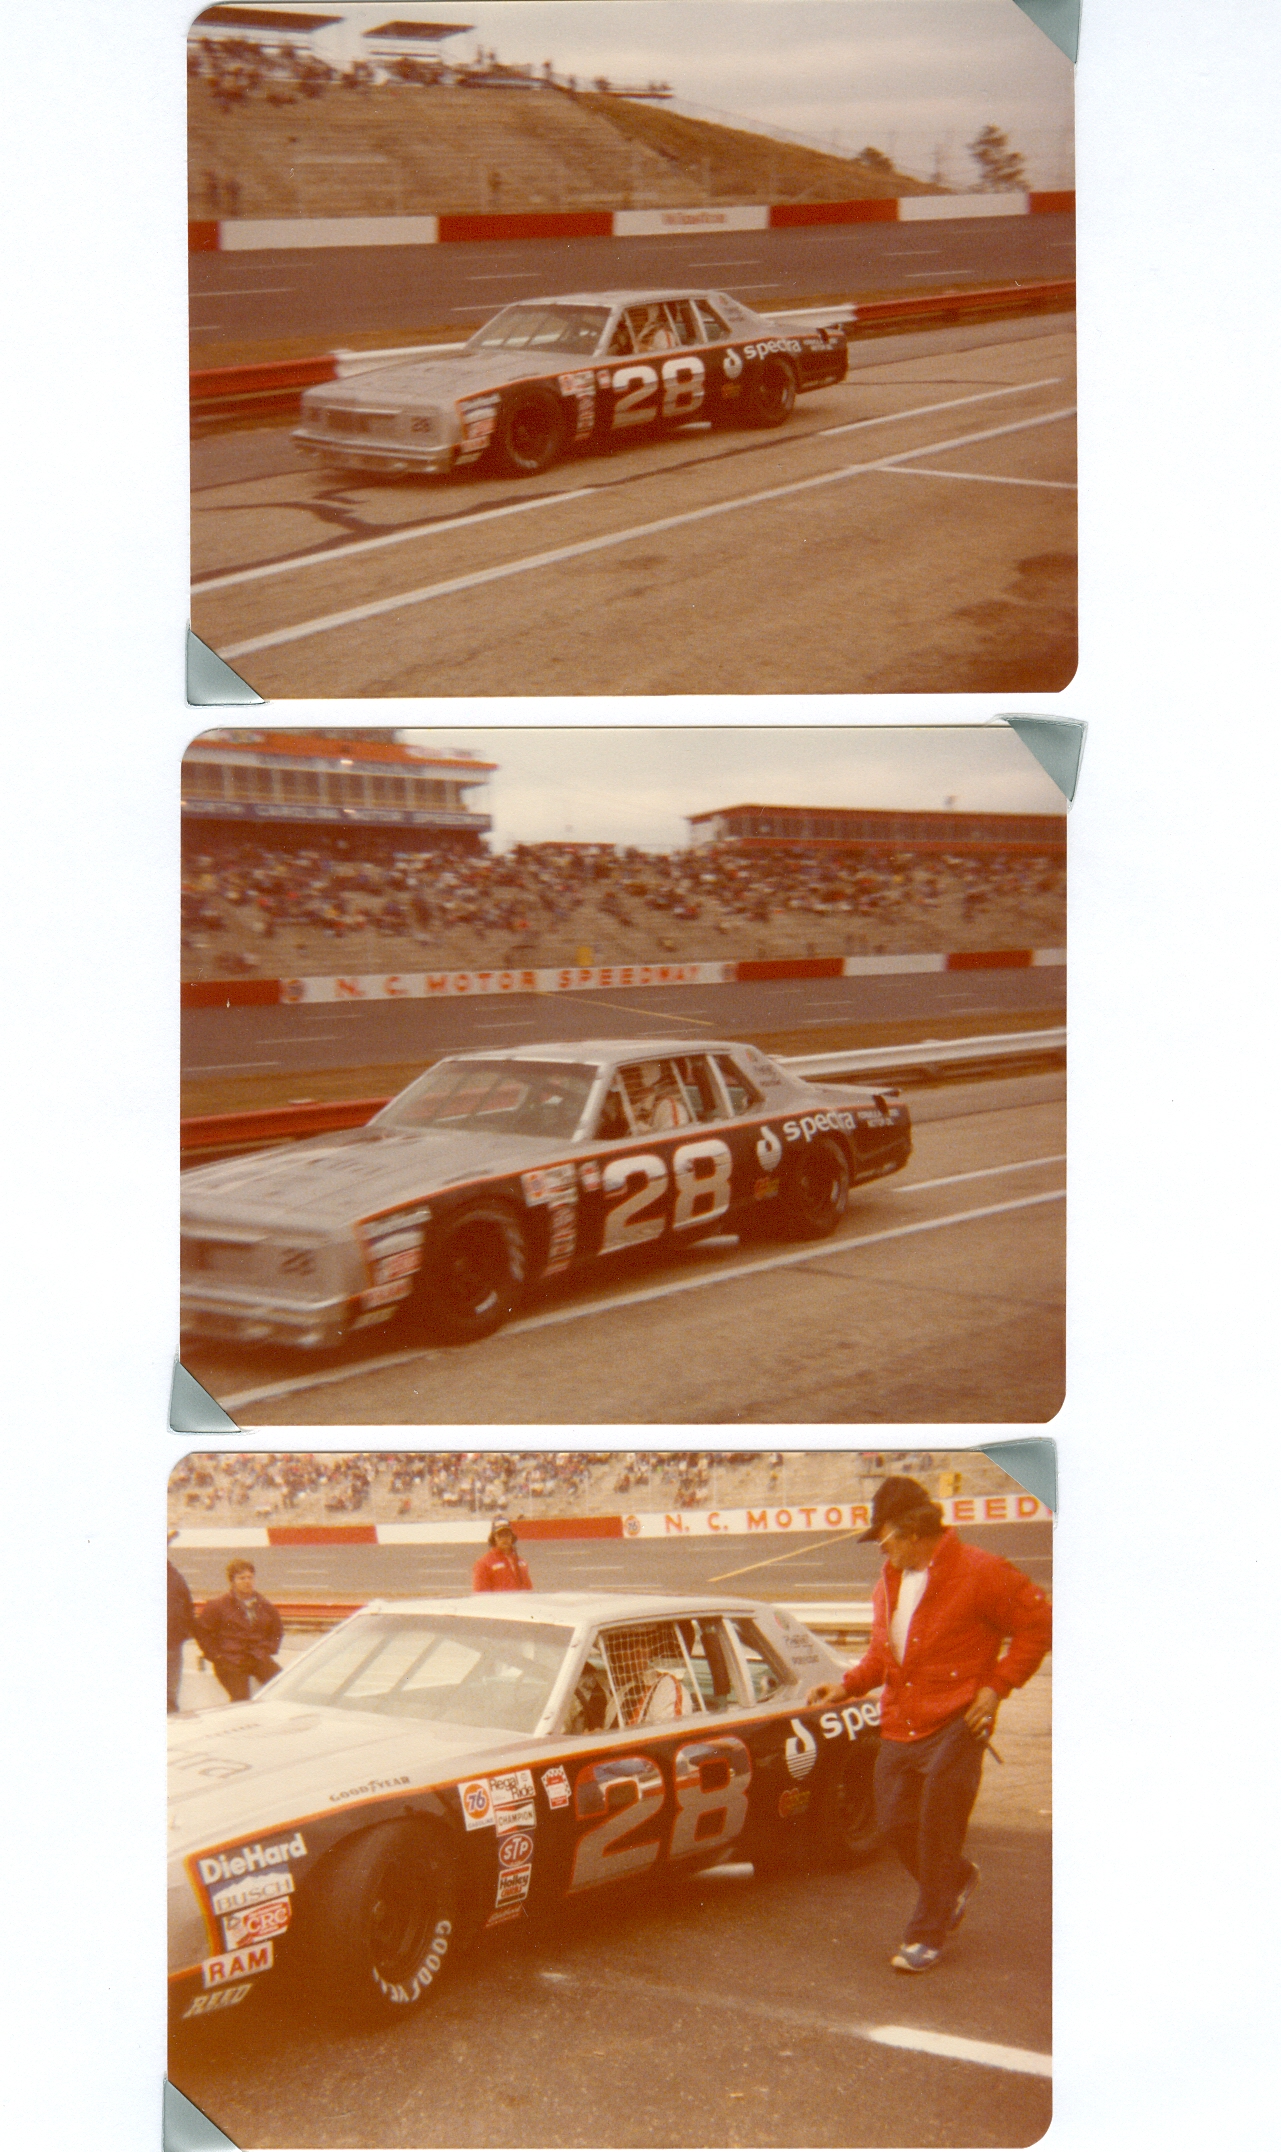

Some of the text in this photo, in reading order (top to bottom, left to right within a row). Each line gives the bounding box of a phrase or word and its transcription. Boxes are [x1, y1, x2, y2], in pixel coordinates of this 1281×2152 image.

[611, 357, 706, 429] 28
[424, 970, 537, 995] MOTOR
[558, 965, 699, 989] SPEEDWAY
[598, 1139, 733, 1257] 28
[664, 1495, 1054, 1533] N. C. MOTOR EED
[328, 1775, 411, 1802] GOODYEAR
[489, 1773, 519, 1792] Regal
[511, 1783, 534, 1800] Ride
[467, 1788, 487, 1812] 76
[499, 1809, 533, 1826] CHAMPION
[566, 1735, 753, 1895] 28
[197, 1832, 307, 1886] DieHard
[503, 1837, 529, 1860] STP
[216, 1878, 292, 1913] BUSCH
[500, 1874, 529, 1891] Holley
[246, 1907, 288, 1934] CRC
[209, 1947, 269, 1984] RAM
